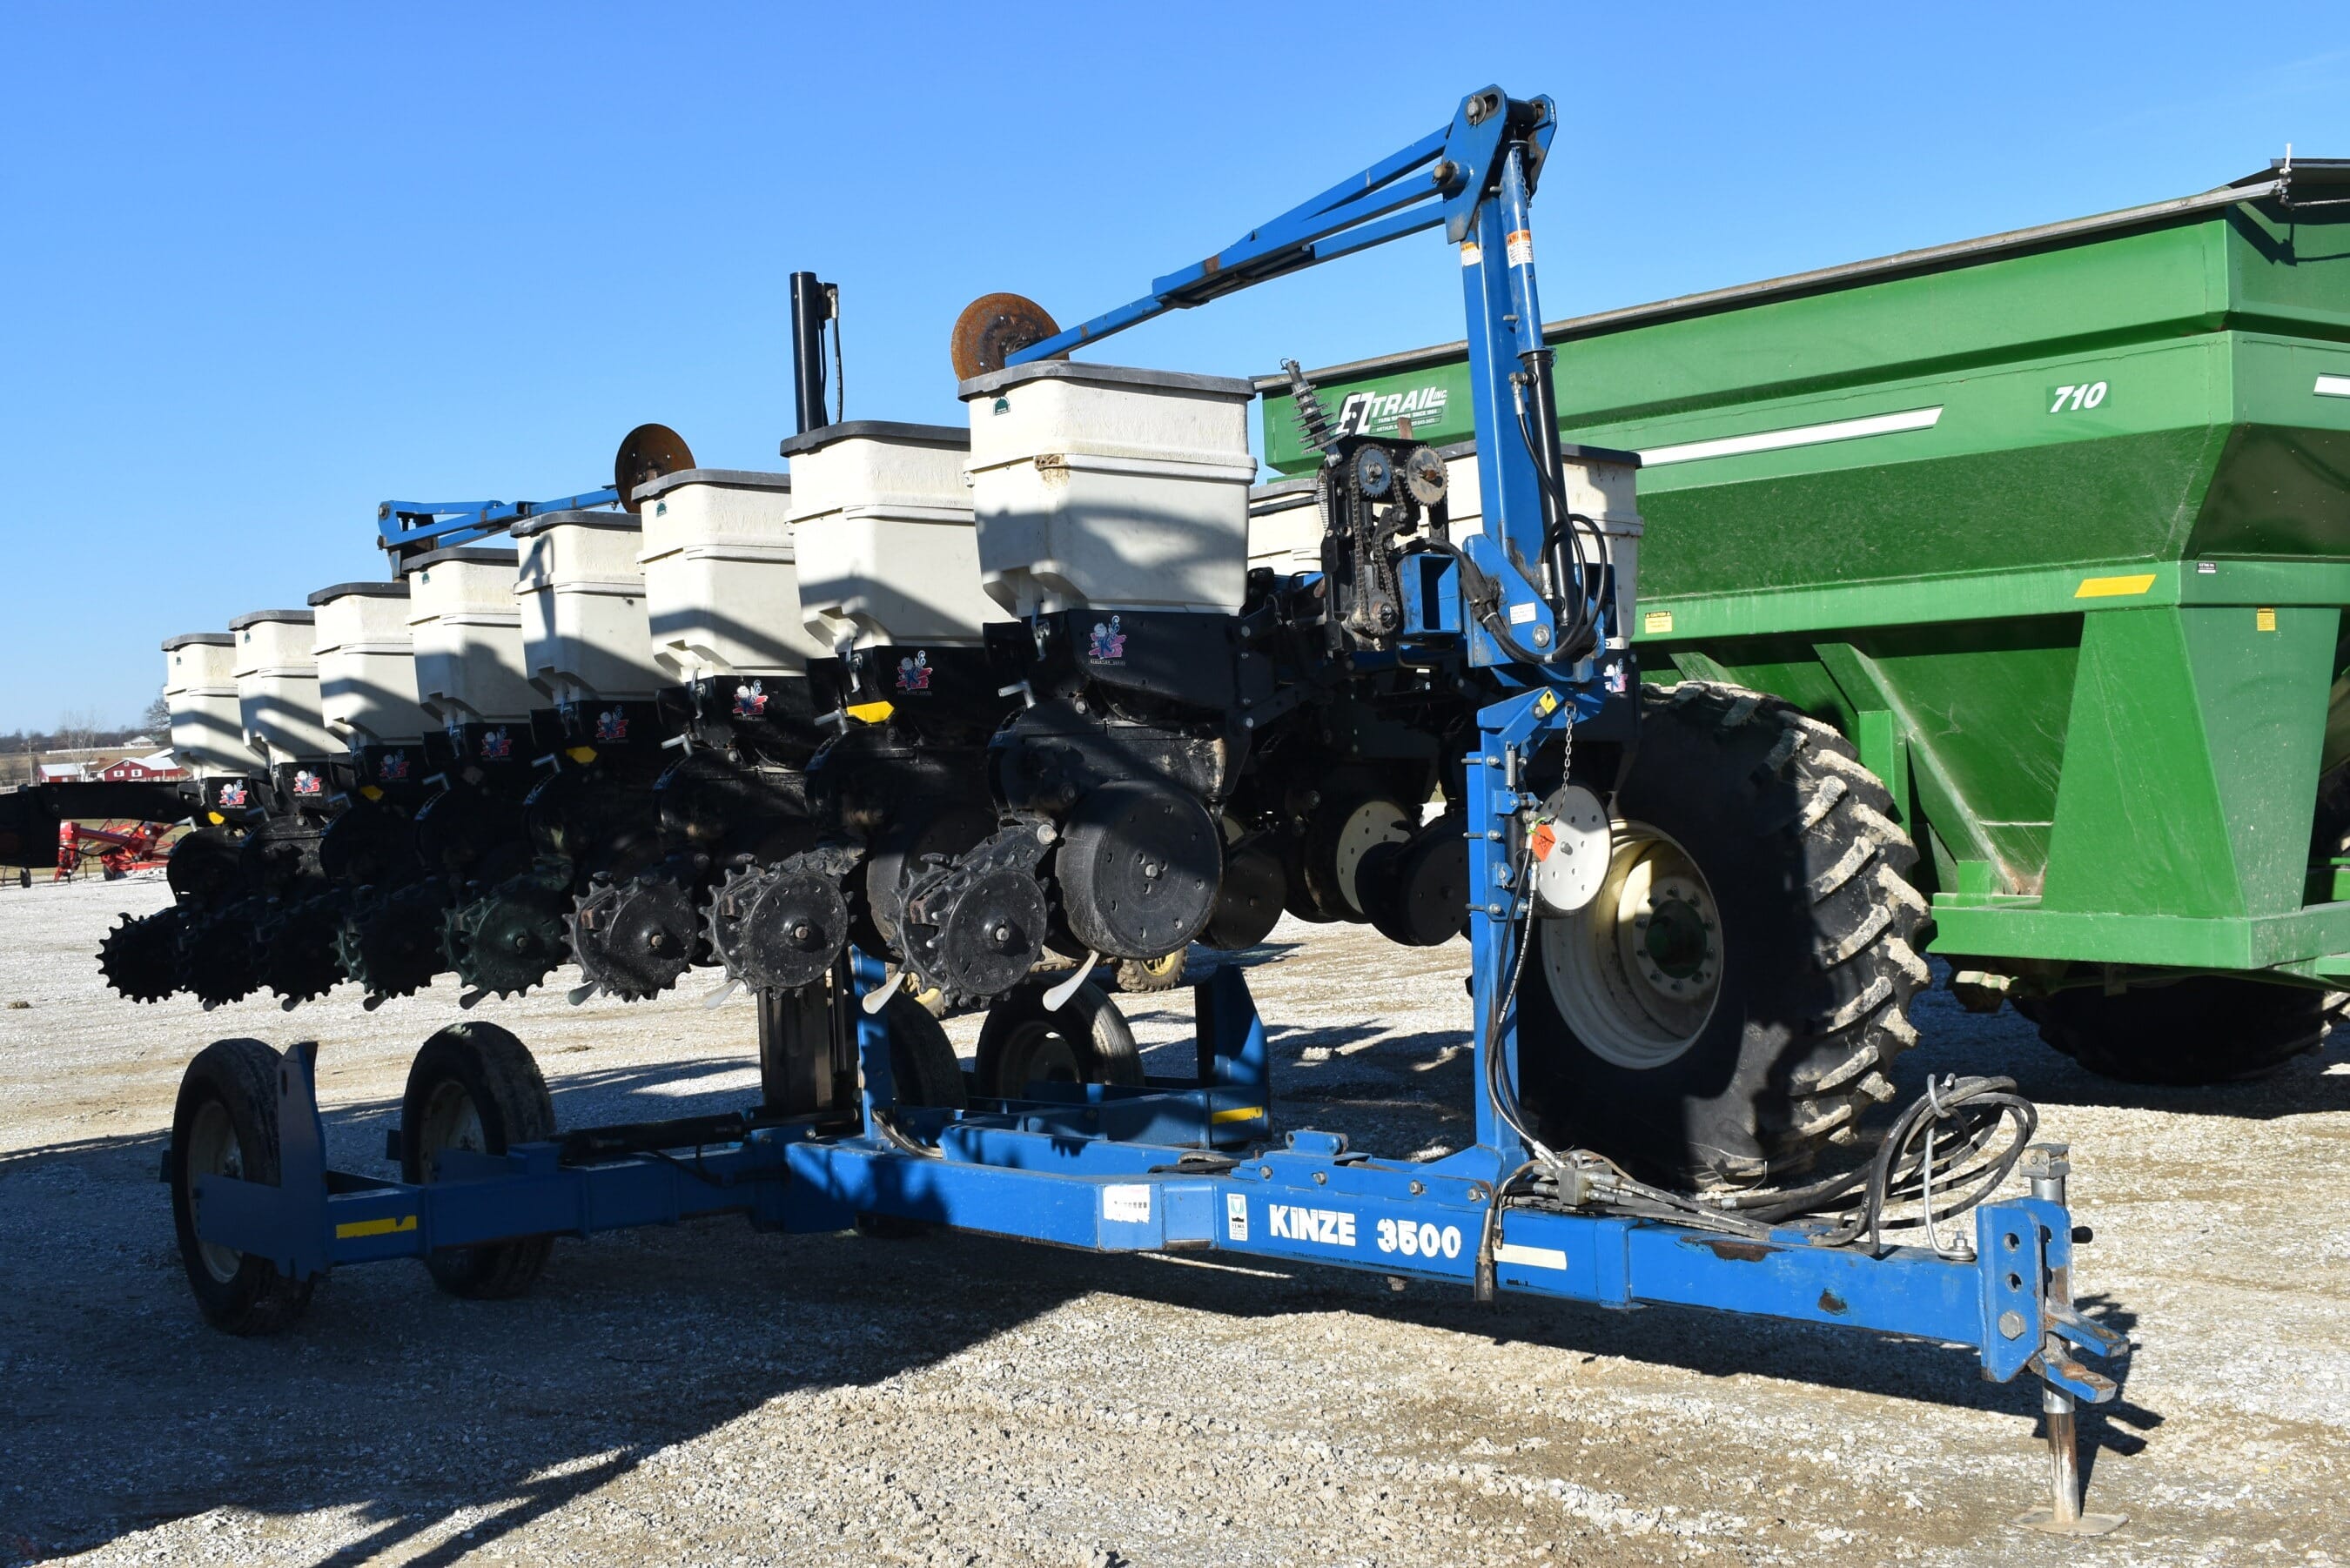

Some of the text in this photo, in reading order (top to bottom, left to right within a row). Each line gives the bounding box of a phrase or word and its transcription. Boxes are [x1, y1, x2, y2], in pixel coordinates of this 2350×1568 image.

[1372, 386, 1446, 418] TRAIL
[2050, 381, 2107, 413] 710
[1269, 1203, 1461, 1259] KINZE 3500
